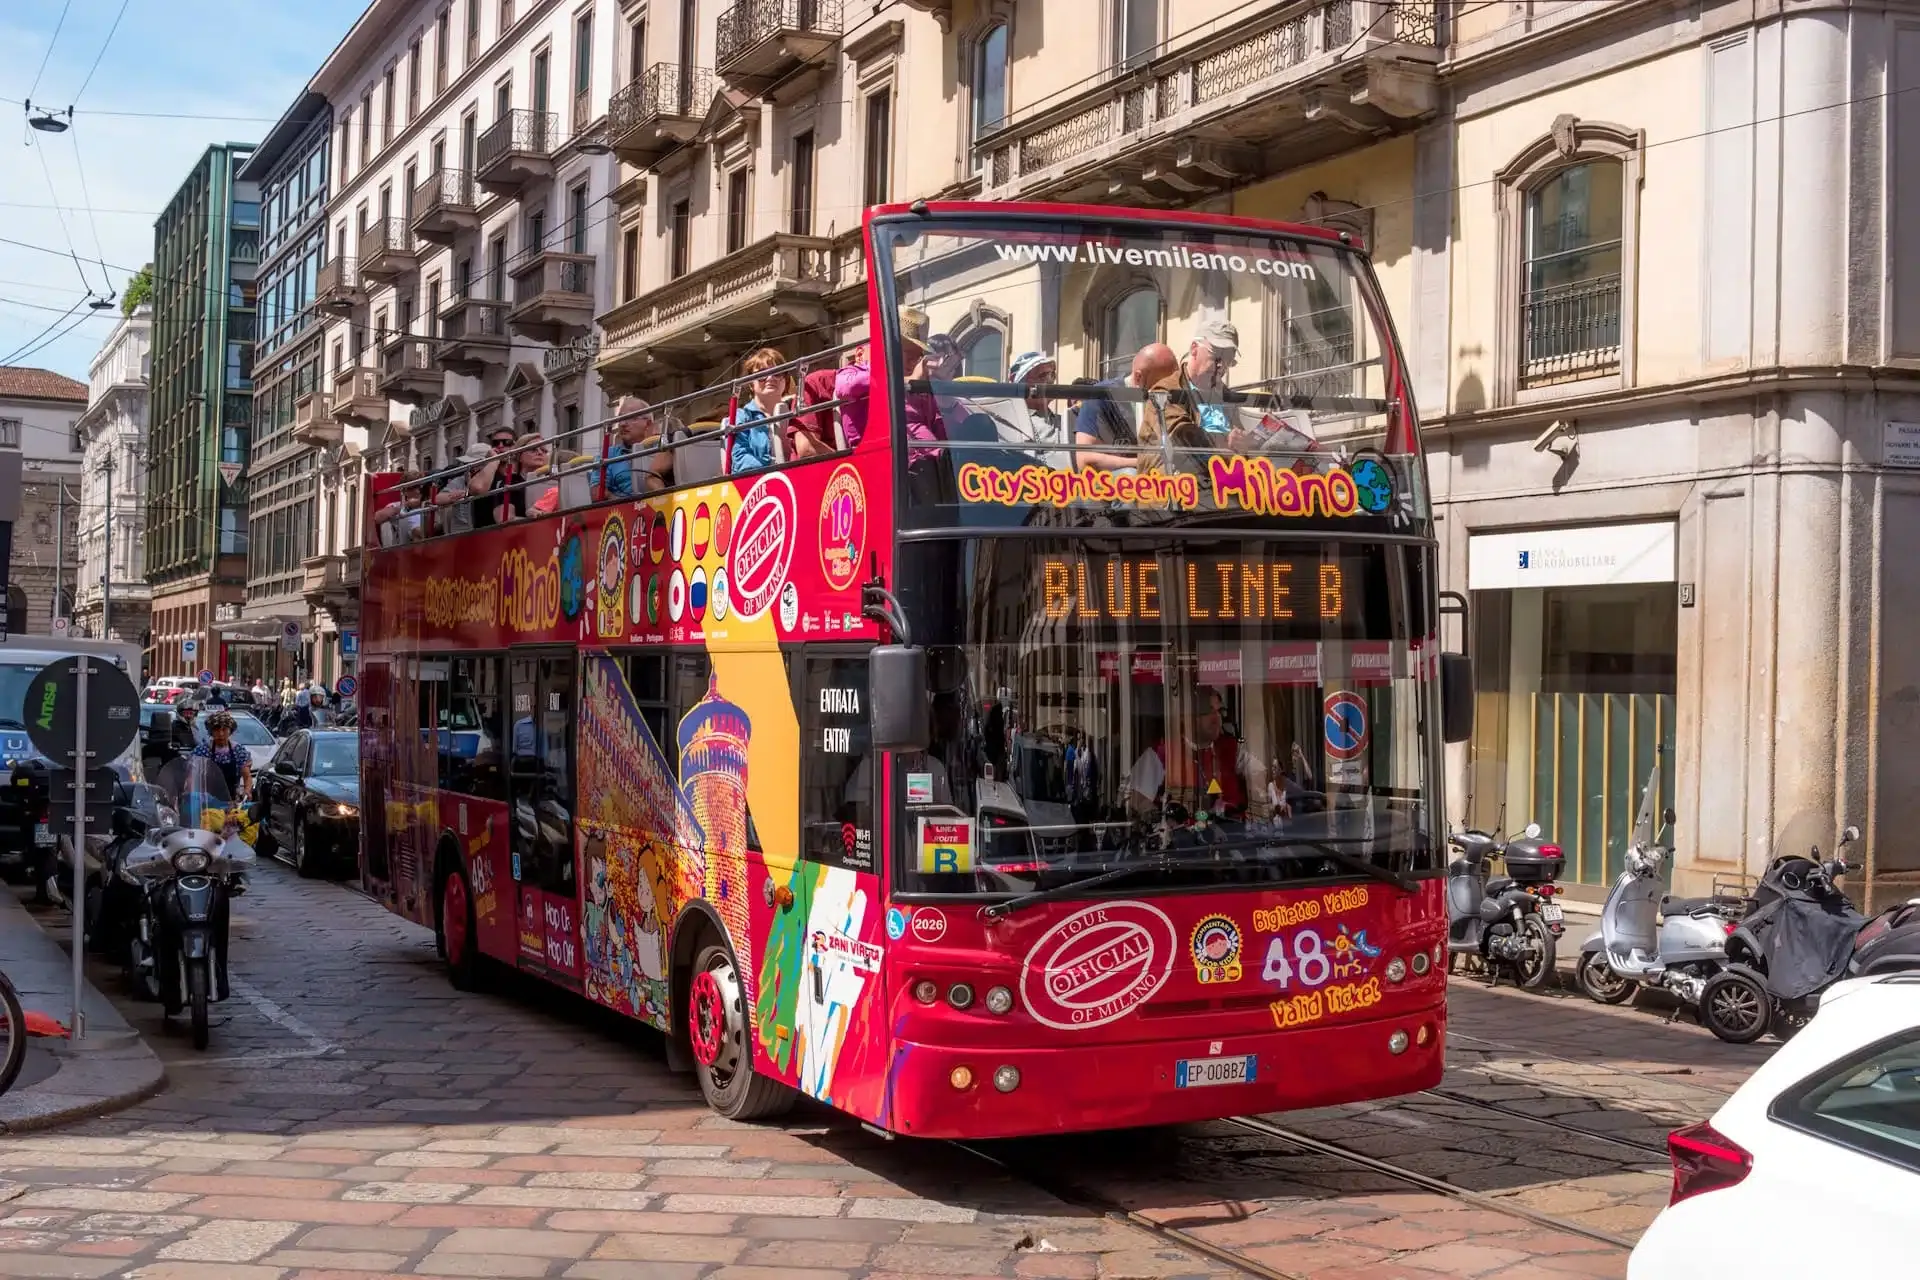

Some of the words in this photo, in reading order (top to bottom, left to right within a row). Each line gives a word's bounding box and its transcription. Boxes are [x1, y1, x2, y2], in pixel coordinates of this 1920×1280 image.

[994, 241, 1316, 281] www.livemilano.com
[744, 483, 767, 517] TOUR
[1208, 455, 1360, 518] Milano
[831, 493, 853, 541] 10
[737, 514, 783, 580] OFFICIAL
[1531, 555, 1617, 569] EUROMOBILIARE
[500, 547, 561, 632] Milano
[743, 597, 755, 615] OF
[754, 562, 784, 611] MILANO
[1044, 561, 1160, 618] BLUE
[1187, 562, 1294, 618] LINE
[1319, 563, 1344, 619] B
[820, 688, 860, 714] ENTRATA
[824, 728, 850, 753] ENTRY
[934, 835, 958, 843] ROUTE
[936, 825, 957, 833] LINEA
[935, 848, 958, 873] B
[545, 901, 561, 930] Hop
[915, 918, 943, 930] 2026
[1057, 910, 1109, 940] TOUR
[1253, 900, 1320, 932] Biglietto
[1323, 887, 1369, 914] Valido
[829, 935, 849, 953] ZANI
[1195, 920, 1233, 944] COMMENTARY
[547, 935, 562, 965] Hop
[563, 941, 575, 968] Off
[1052, 935, 1149, 994] OFFICIAL
[1262, 929, 1330, 989] 48
[1071, 1009, 1095, 1023] OF
[1099, 974, 1157, 1018] MILANO
[1270, 991, 1323, 1028] Valid
[1325, 976, 1382, 1014] Ticket
